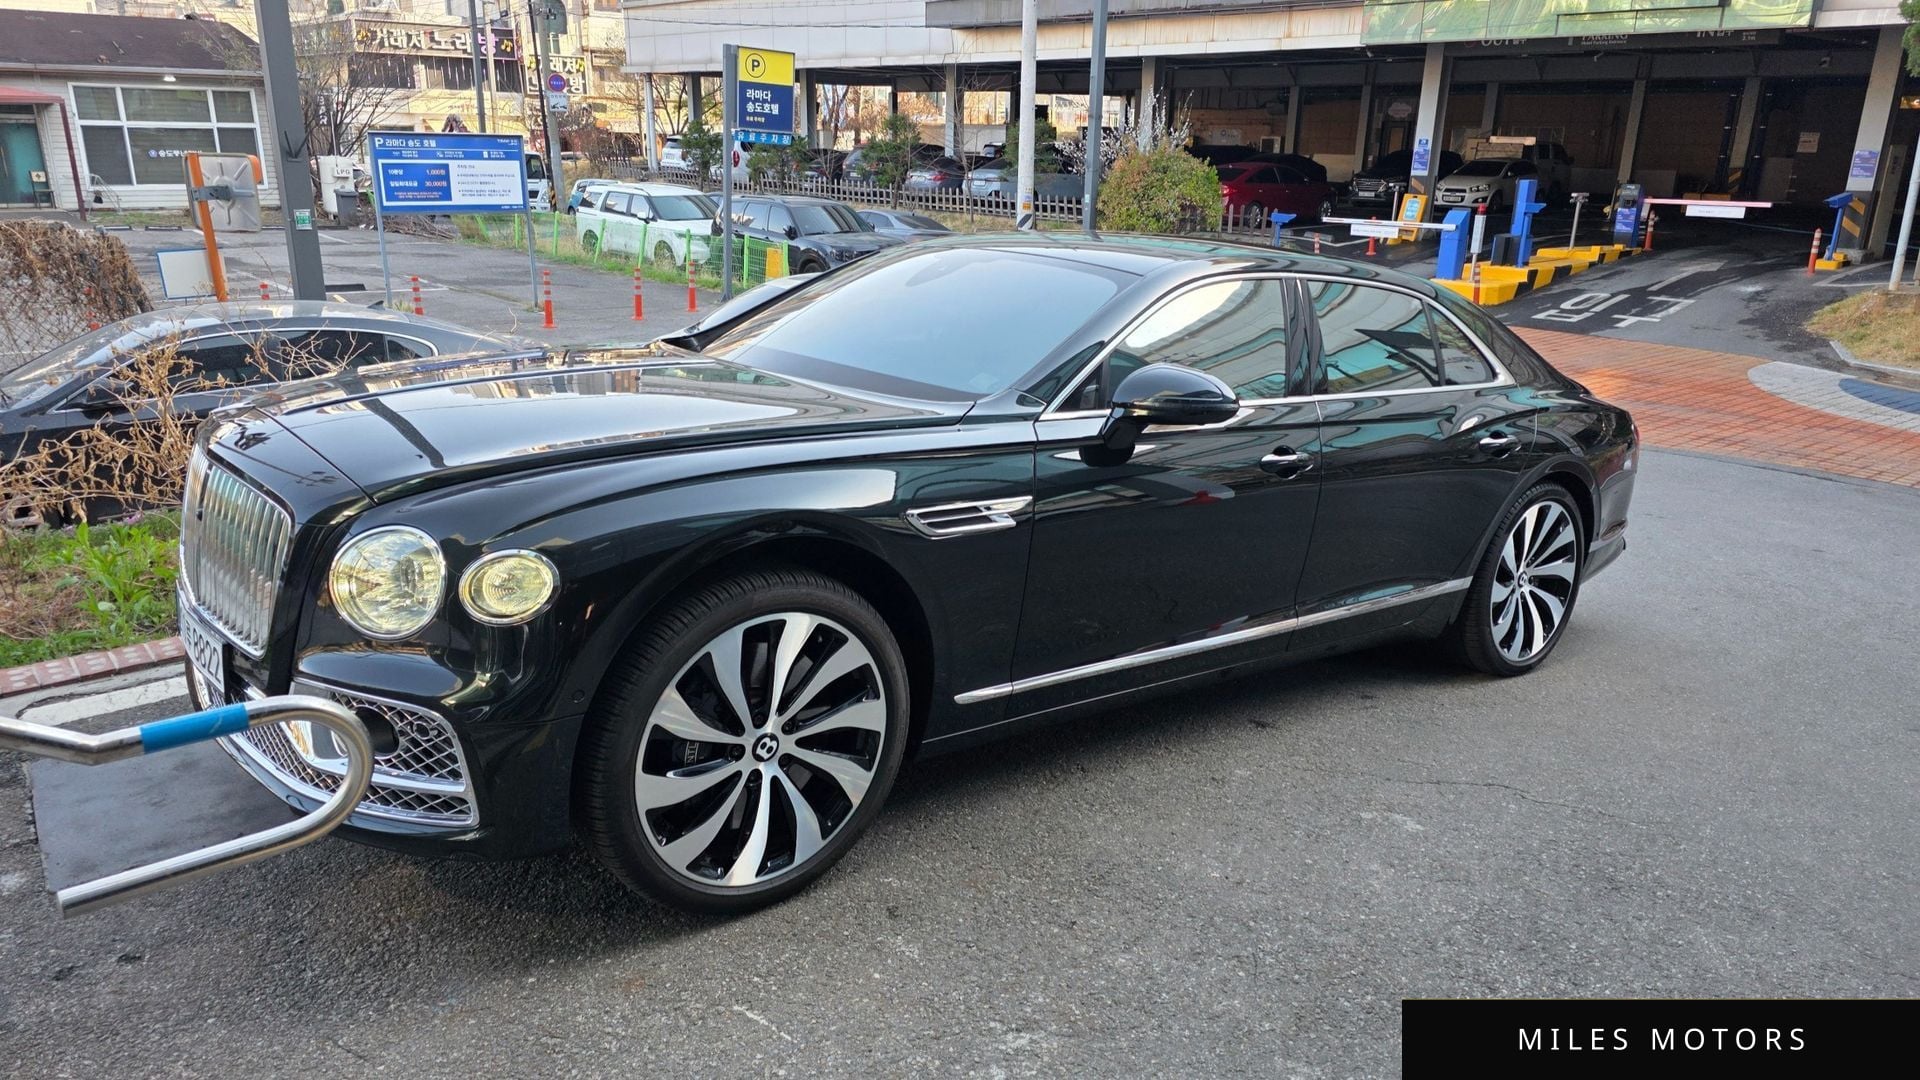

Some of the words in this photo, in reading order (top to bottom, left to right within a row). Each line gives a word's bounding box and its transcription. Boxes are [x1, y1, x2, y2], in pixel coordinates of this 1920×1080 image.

[751, 59, 760, 72] P
[746, 89, 772, 101] 라마다
[746, 102, 779, 115] 송도호텔
[385, 138, 406, 147] 라마다
[408, 139, 422, 147] 송도
[423, 139, 437, 148] 호텔
[1531, 293, 1697, 328] 입구
[193, 627, 222, 685] 8822
[756, 737, 777, 760] B
